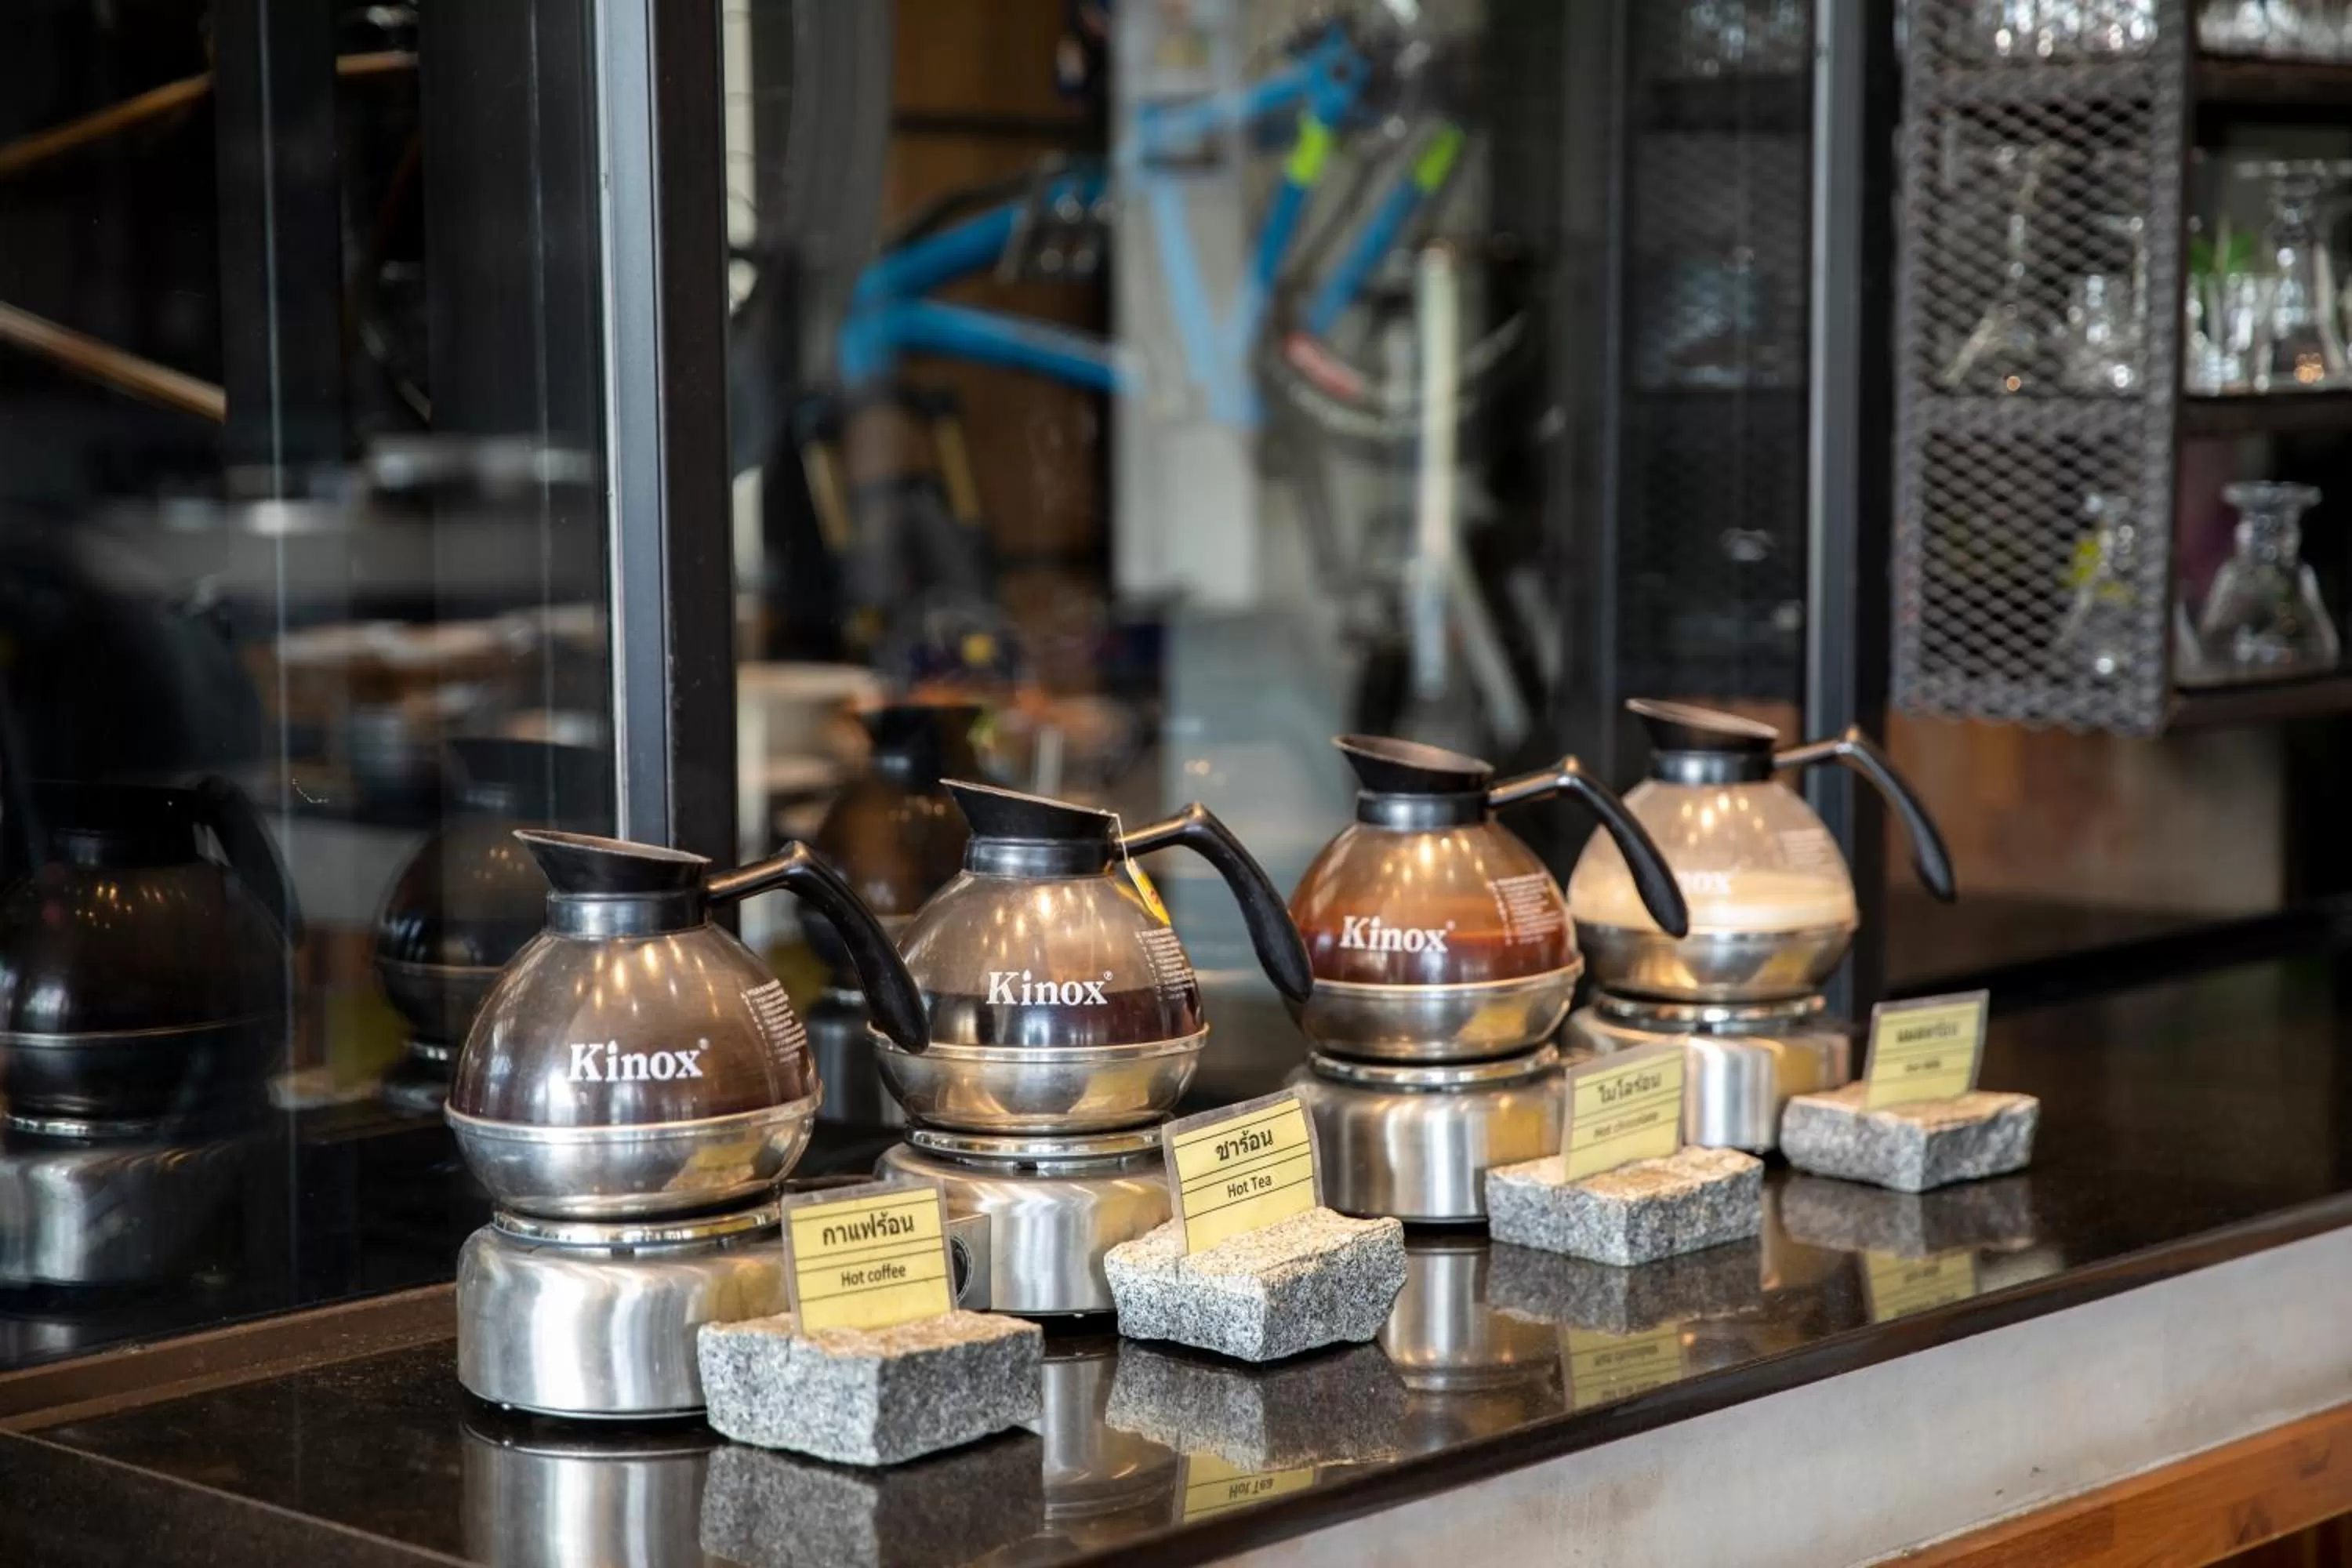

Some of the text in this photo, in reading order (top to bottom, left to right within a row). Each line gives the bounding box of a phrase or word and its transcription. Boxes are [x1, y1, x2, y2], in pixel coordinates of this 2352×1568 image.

[1215, 1129, 1274, 1162] ชาร้อน
[1227, 1175, 1272, 1199] Hot Tea
[822, 1210, 915, 1247] กาแฟร้อน
[840, 1263, 906, 1287] Hot coffee
